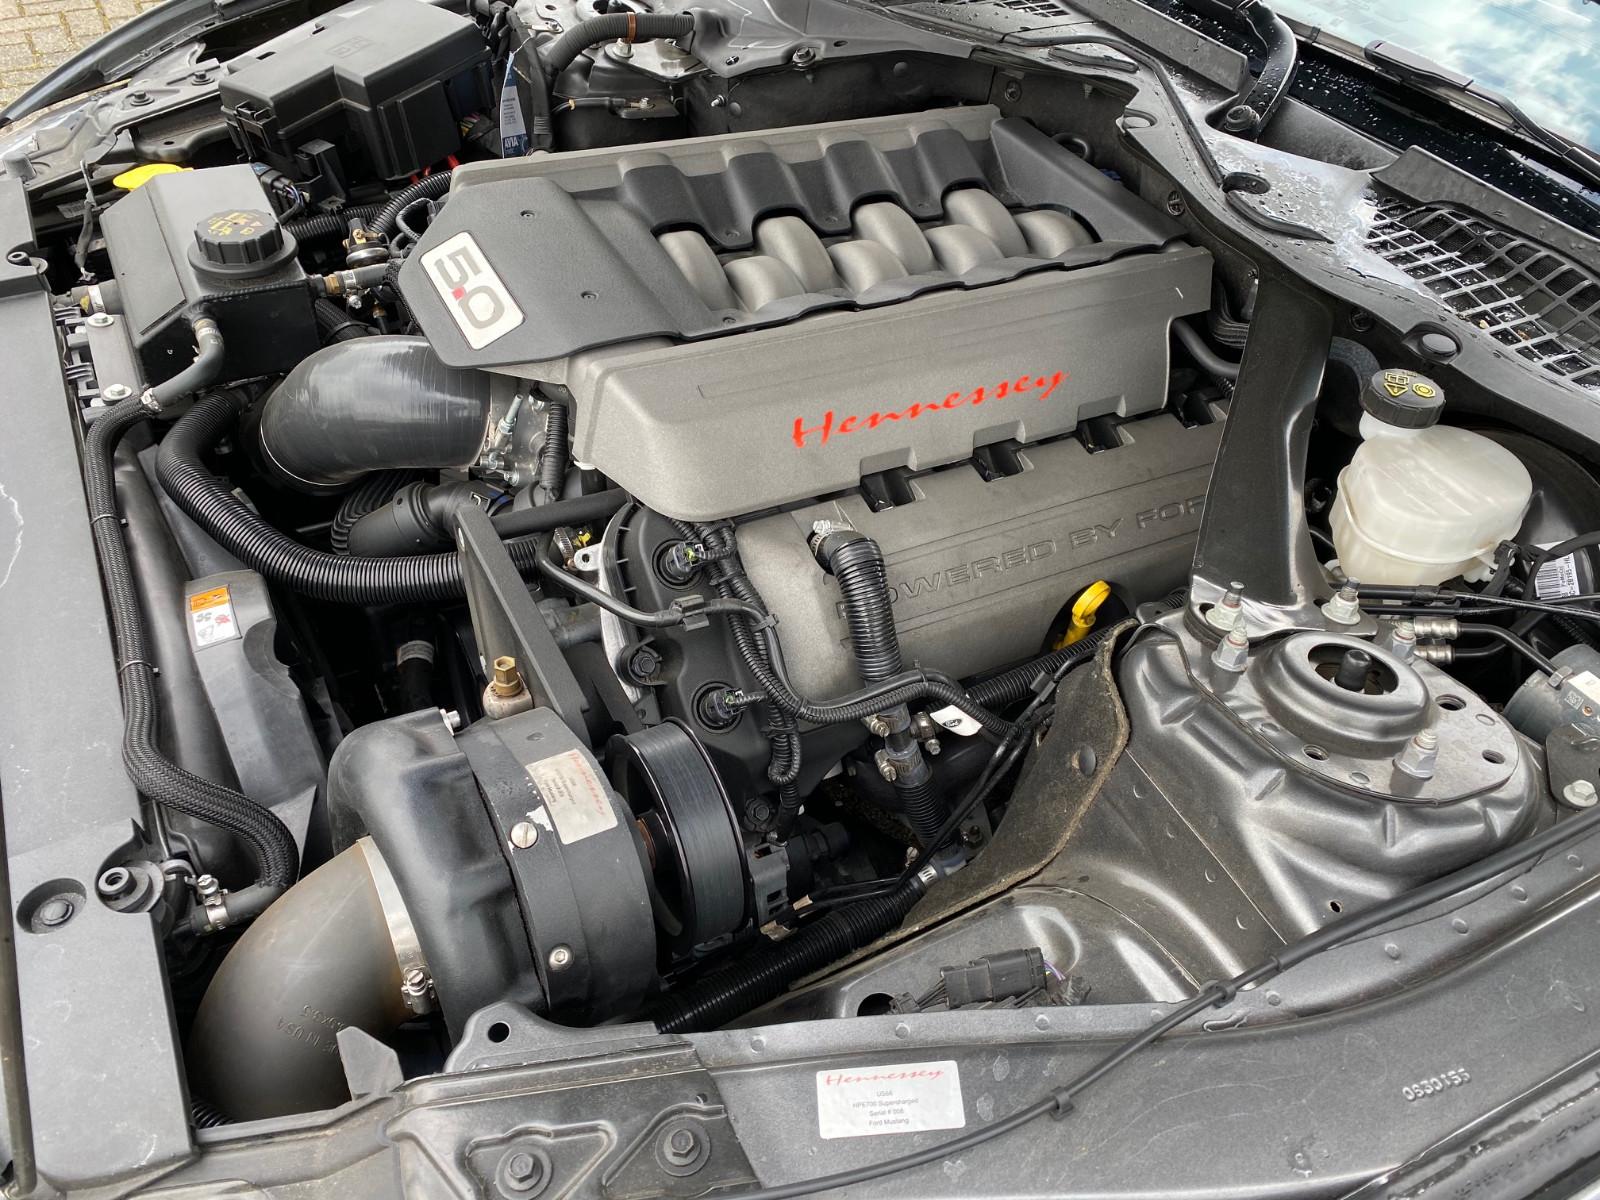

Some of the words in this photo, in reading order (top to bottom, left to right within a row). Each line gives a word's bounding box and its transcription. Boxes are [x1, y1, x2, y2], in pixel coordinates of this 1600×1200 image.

[435, 247, 504, 329] 5.0
[792, 370, 1067, 449] Hennessey
[1068, 516, 1124, 550] BY
[825, 1070, 944, 1086] Hennessey
[878, 1098, 919, 1107] Supercharged
[869, 1109, 887, 1117] Serial
[884, 1117, 910, 1125] Mustang
